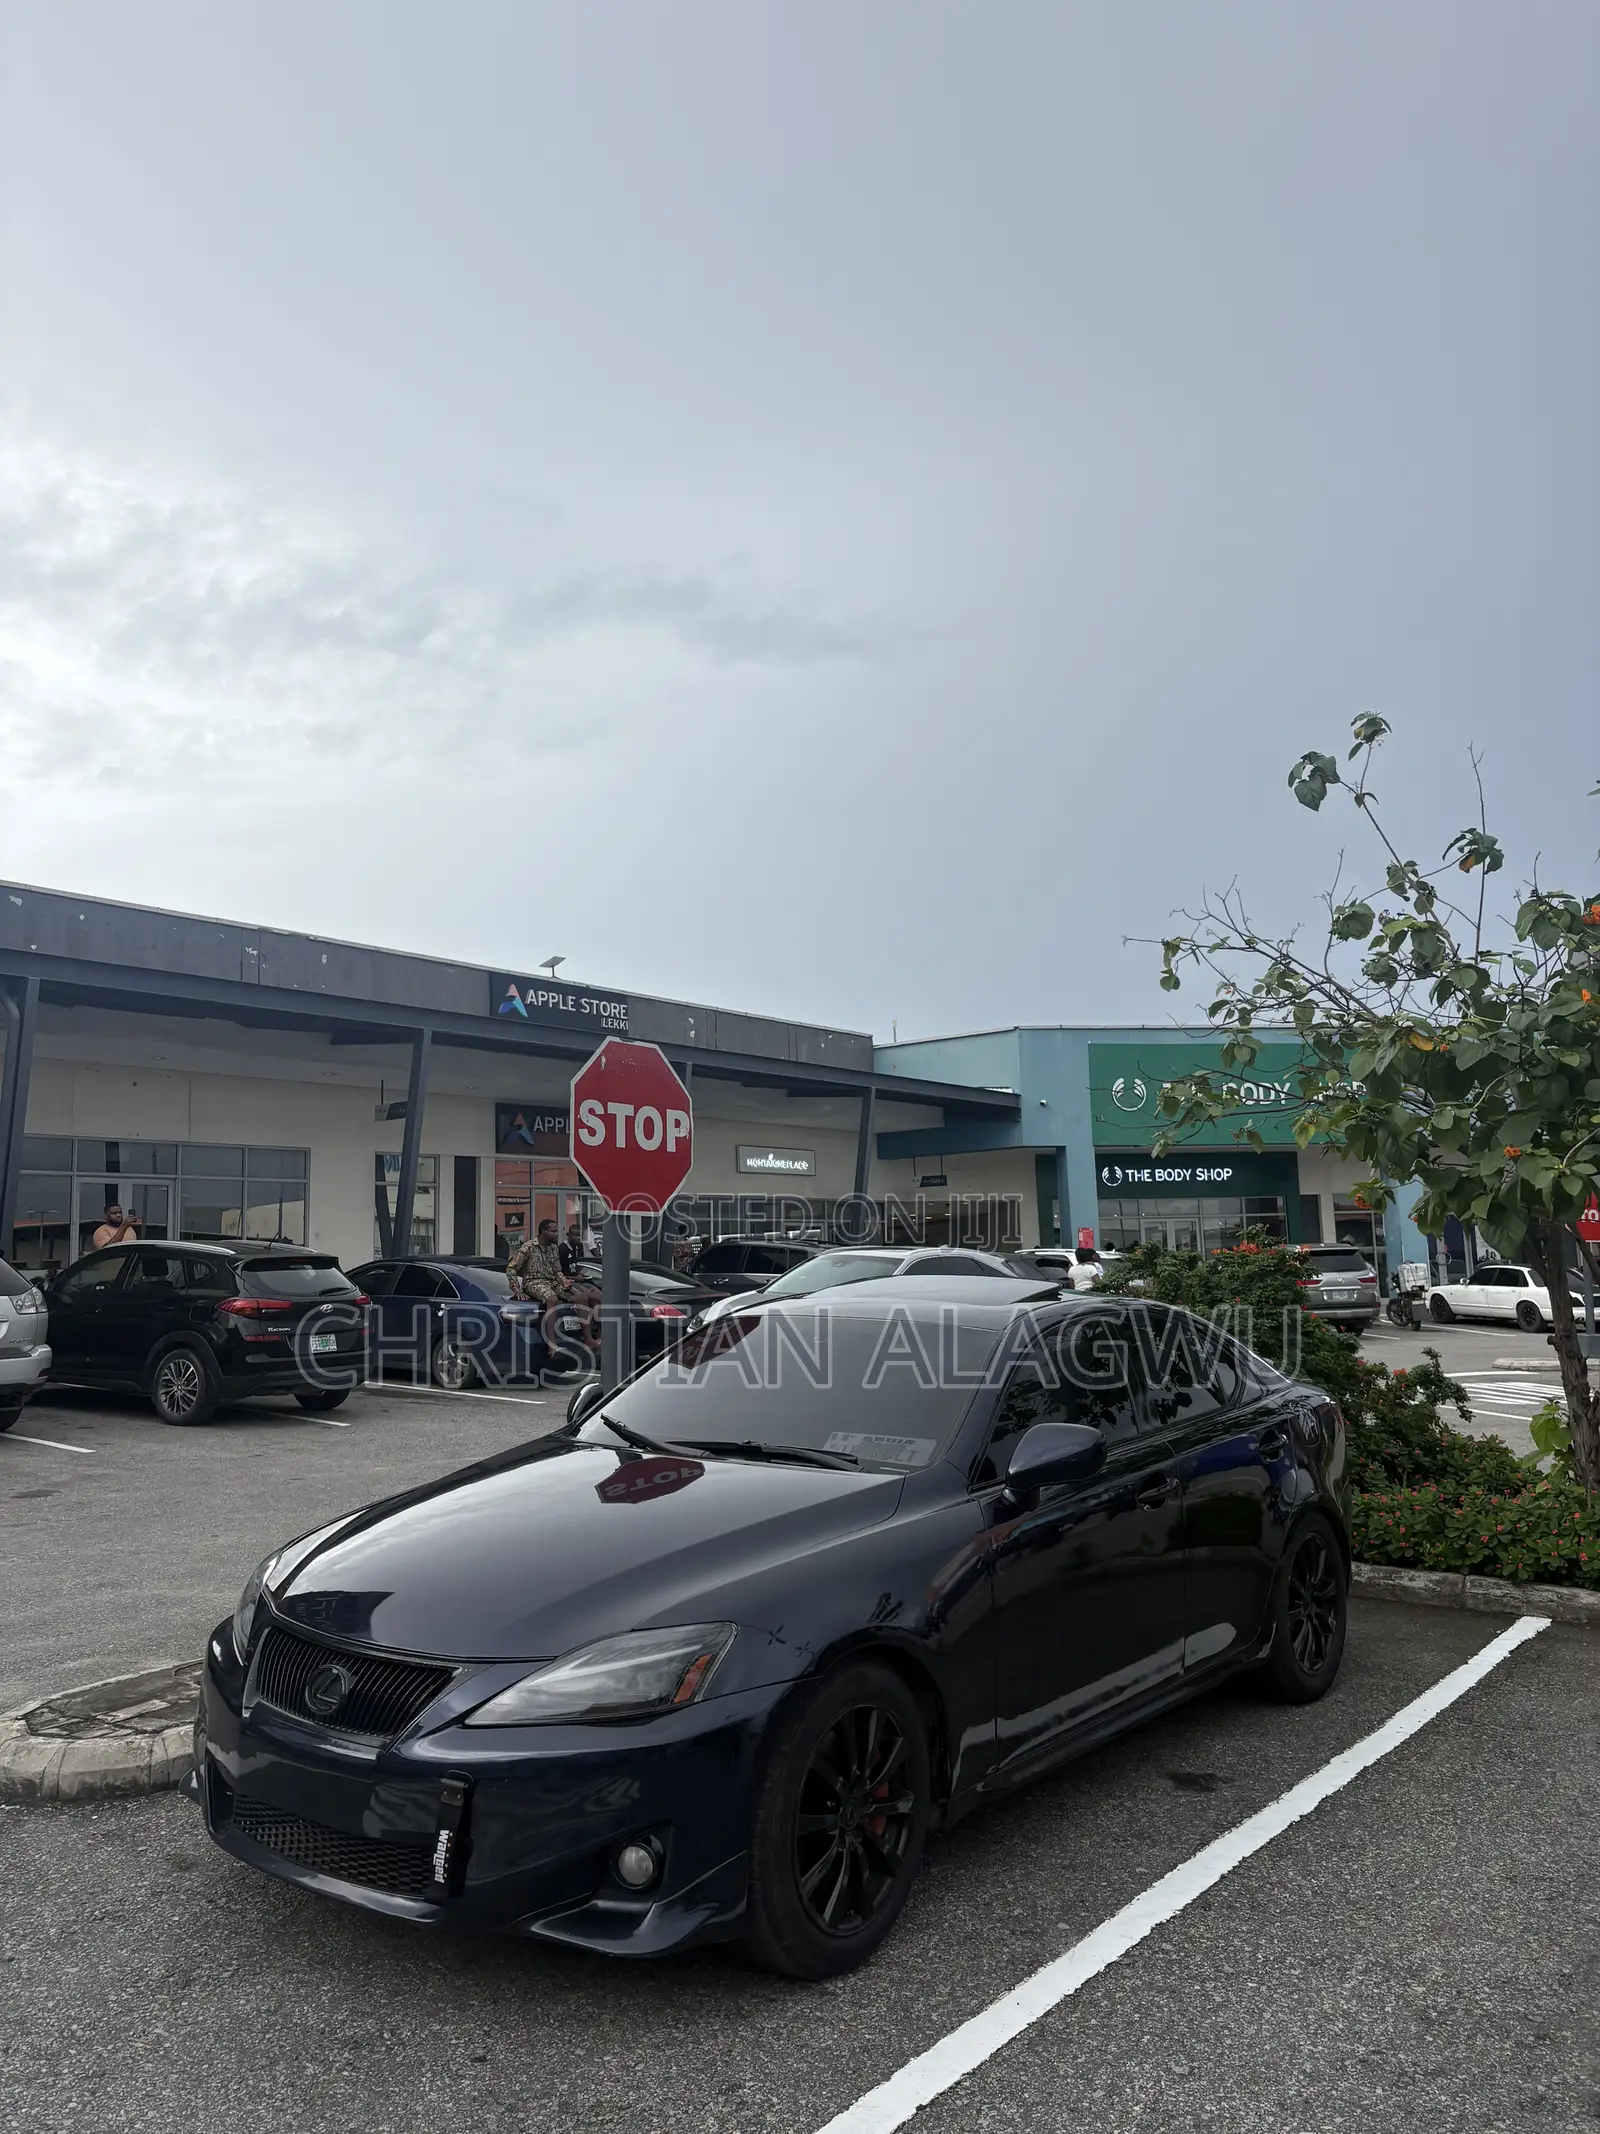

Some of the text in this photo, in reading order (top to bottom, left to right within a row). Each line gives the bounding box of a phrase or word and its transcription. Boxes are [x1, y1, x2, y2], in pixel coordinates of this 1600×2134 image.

[527, 989, 628, 1020] APPLE STORE
[602, 1017, 629, 1030] LEKKI
[578, 1099, 690, 1152] STOP
[1125, 1167, 1233, 1182] THE BODY SHOP
